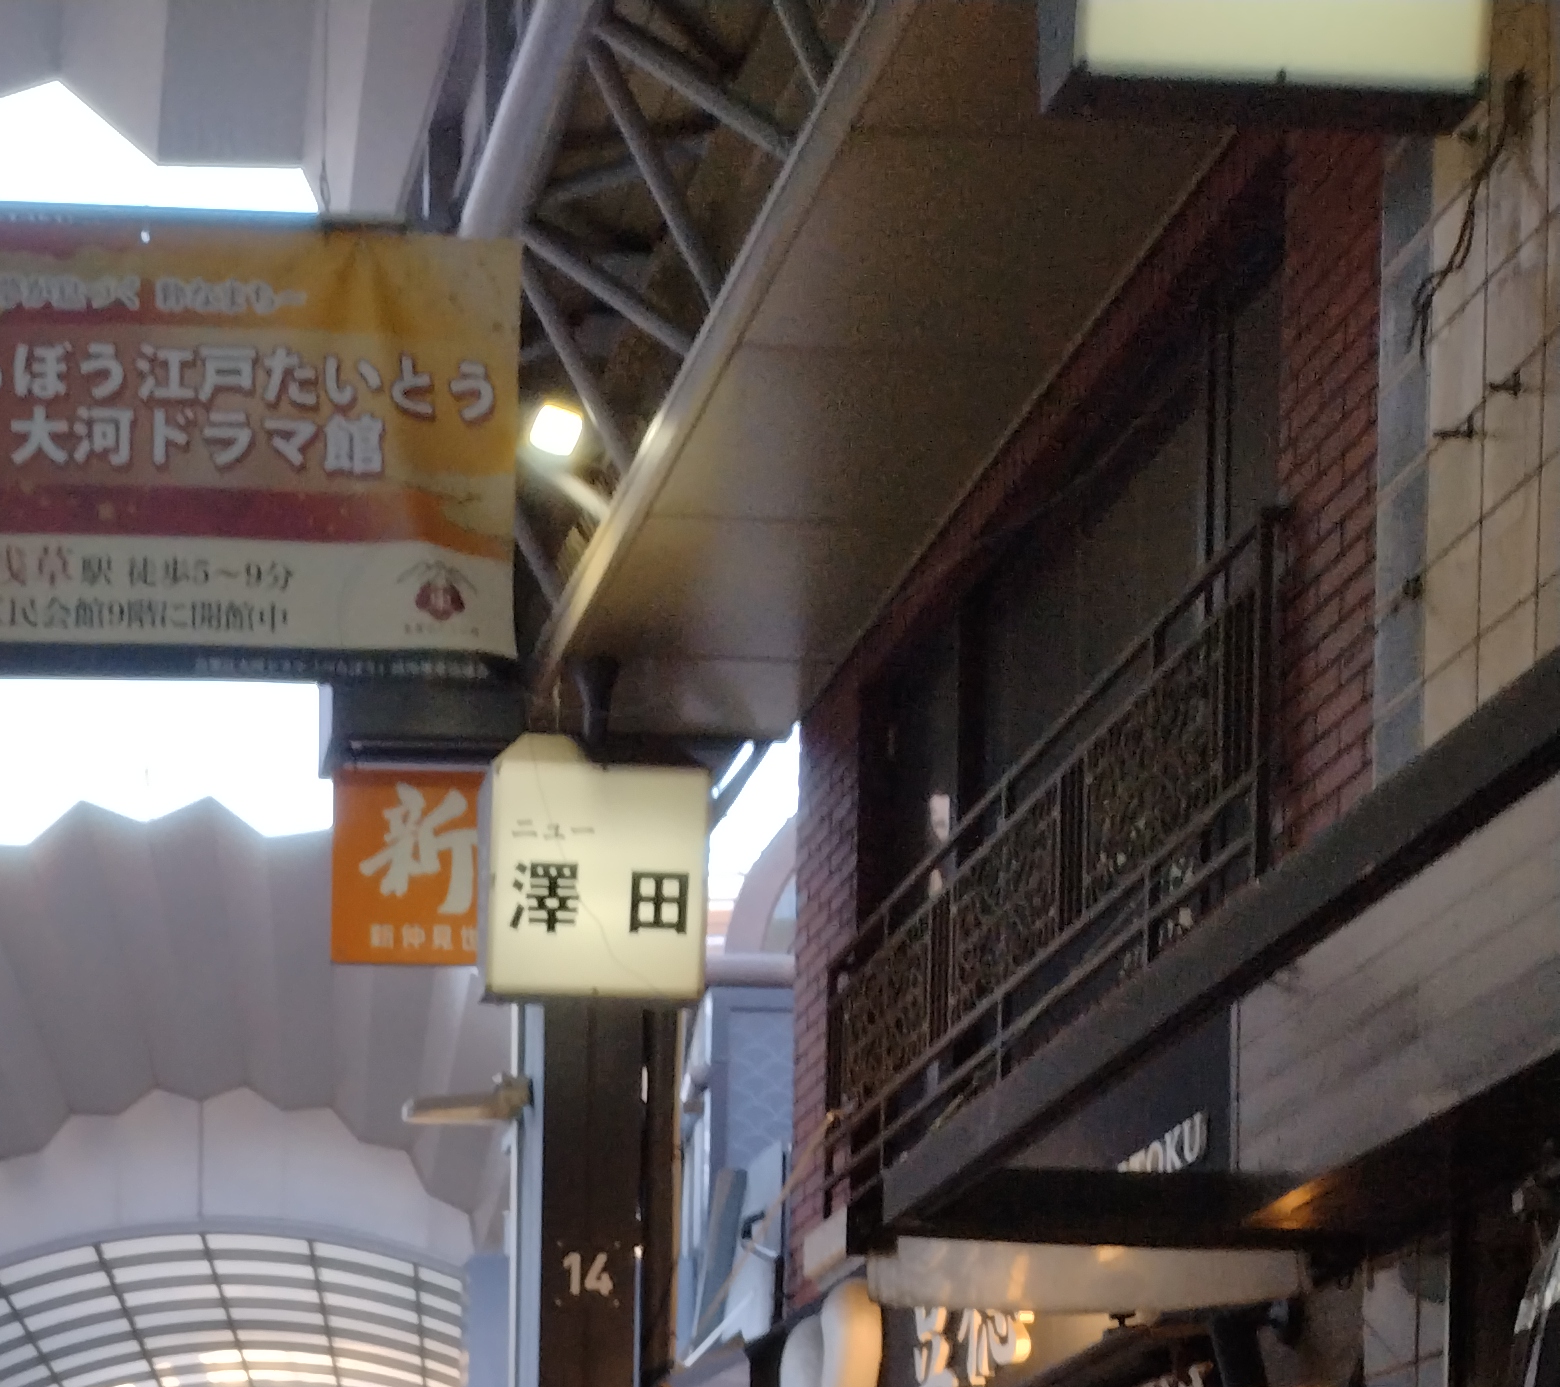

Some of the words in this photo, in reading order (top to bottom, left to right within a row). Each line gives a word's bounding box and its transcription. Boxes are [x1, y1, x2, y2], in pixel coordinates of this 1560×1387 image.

[10, 404, 384, 474] 大河ドラマ館
[358, 781, 477, 916] 新
[509, 861, 690, 936] 澤田
[562, 1251, 614, 1297] 14
